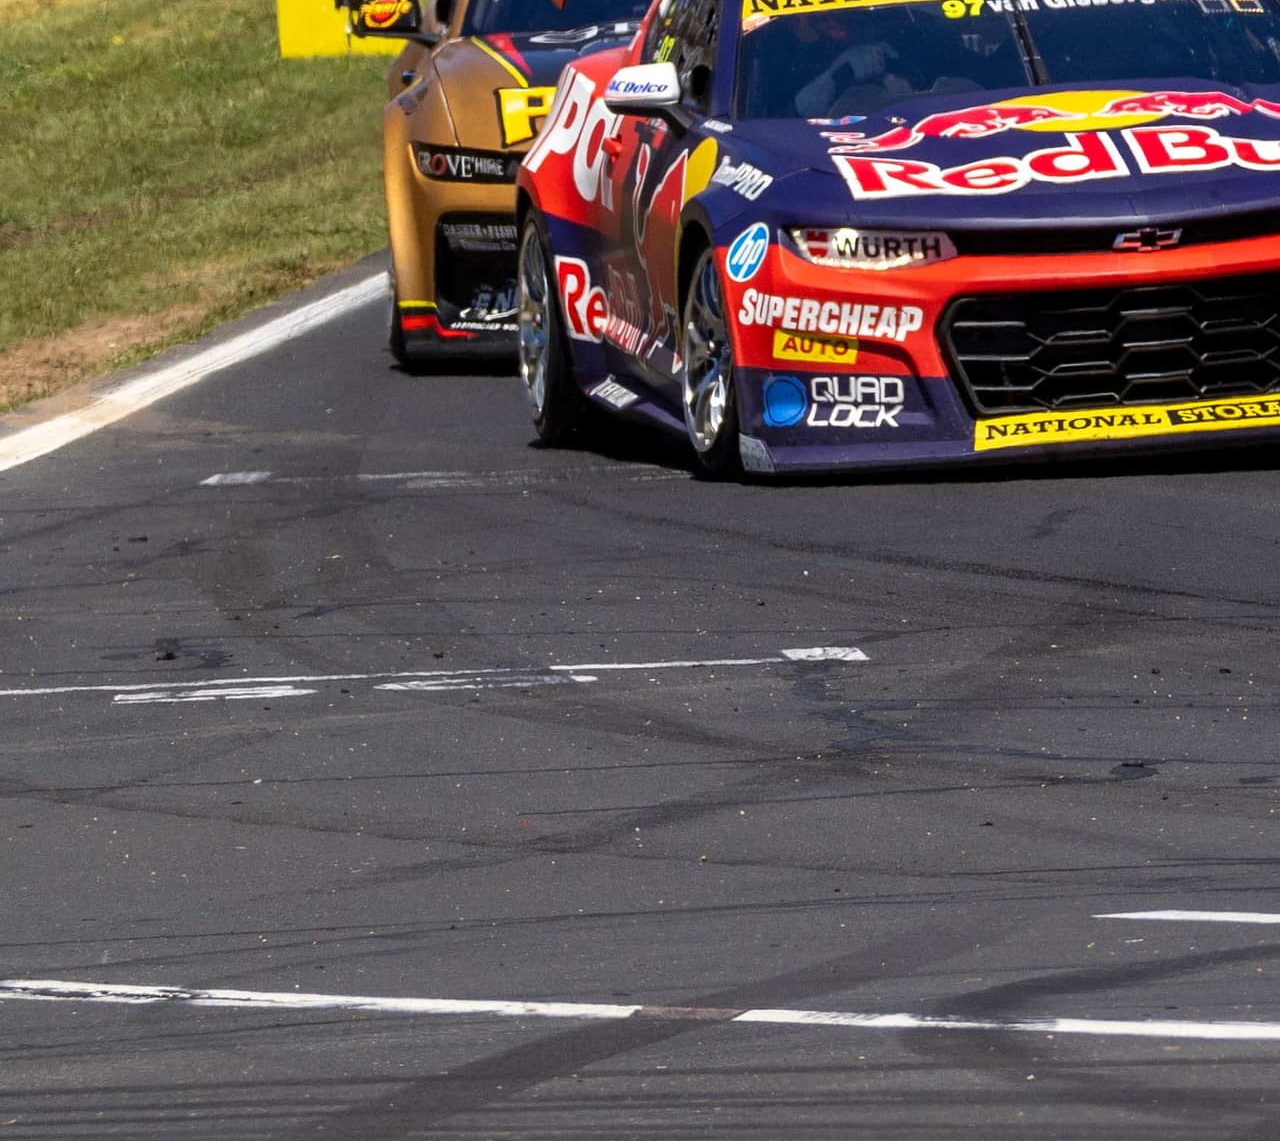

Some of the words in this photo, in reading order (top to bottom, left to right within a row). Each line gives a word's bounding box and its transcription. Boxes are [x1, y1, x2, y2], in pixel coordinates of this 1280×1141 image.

[942, 0, 985, 20] 97
[832, 131, 1131, 201] Red
[728, 224, 768, 281] hp
[835, 235, 942, 260] WÜRTH
[738, 287, 924, 342] SUPERCHEAP
[782, 335, 850, 357] AUTO
[811, 376, 905, 404] QUAD
[806, 404, 902, 428] LOCK
[983, 411, 1163, 441] NATIONAL
